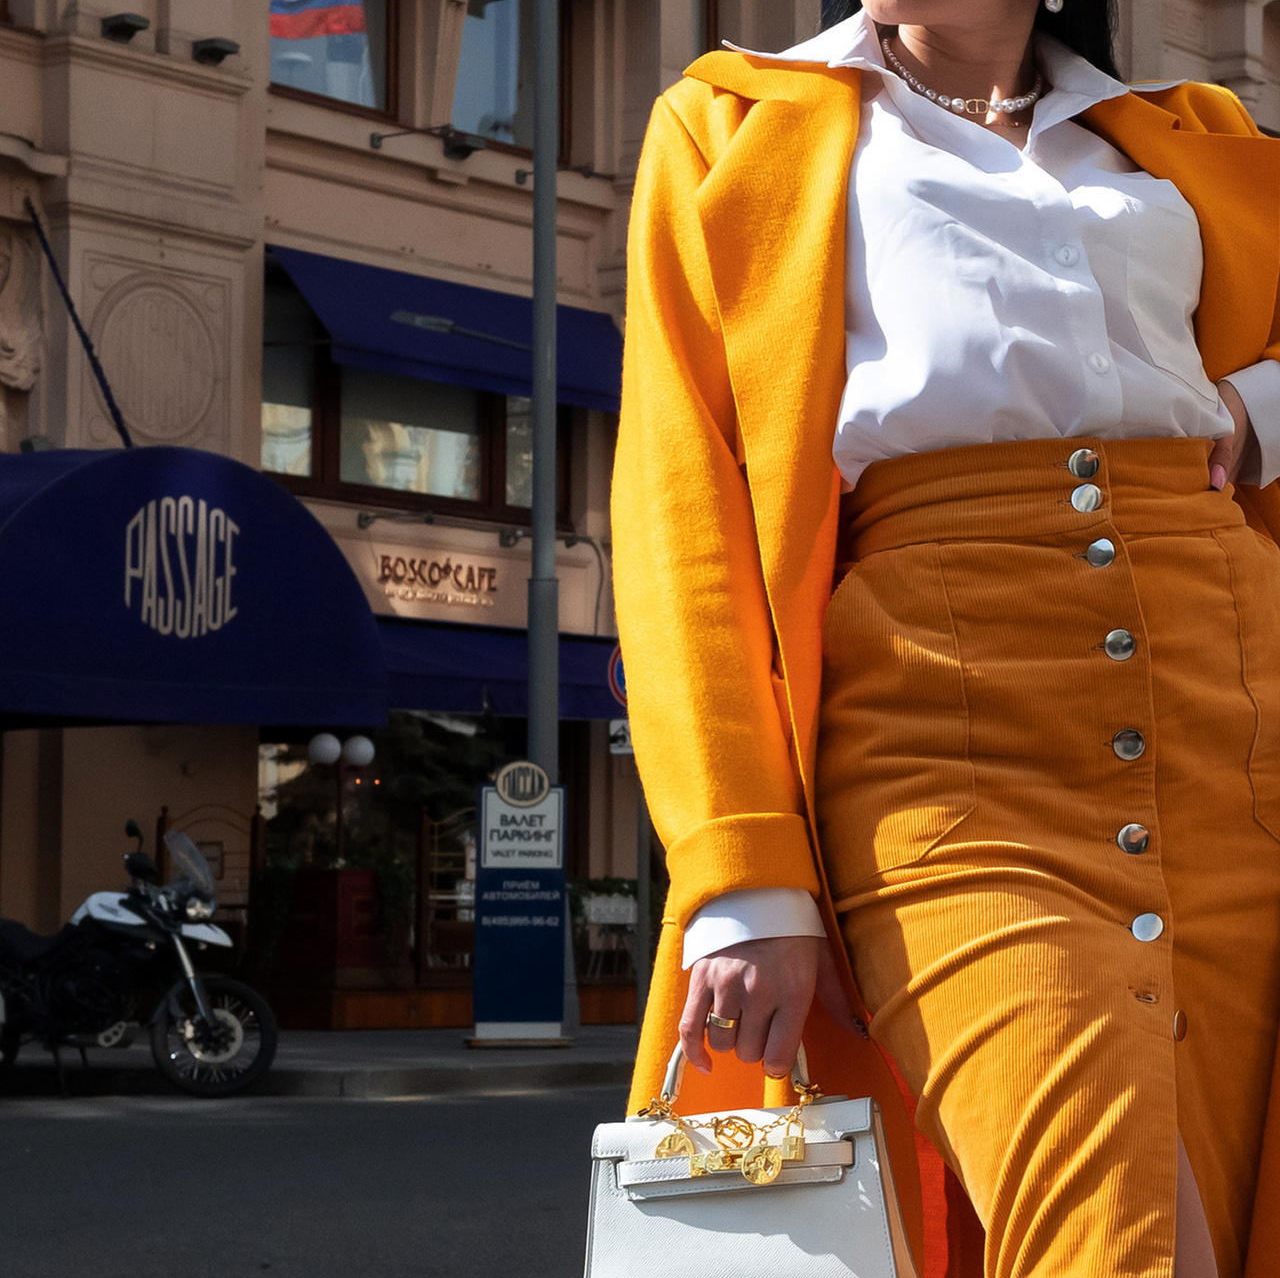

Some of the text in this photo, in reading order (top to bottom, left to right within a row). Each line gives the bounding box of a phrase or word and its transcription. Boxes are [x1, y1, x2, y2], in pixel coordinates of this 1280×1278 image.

[125, 495, 240, 638] PASSAGE
[379, 555, 497, 592] BOSCO CAFE
[500, 814, 546, 827] ВАЛЕТ
[490, 829, 556, 841] ПАРКИНГ
